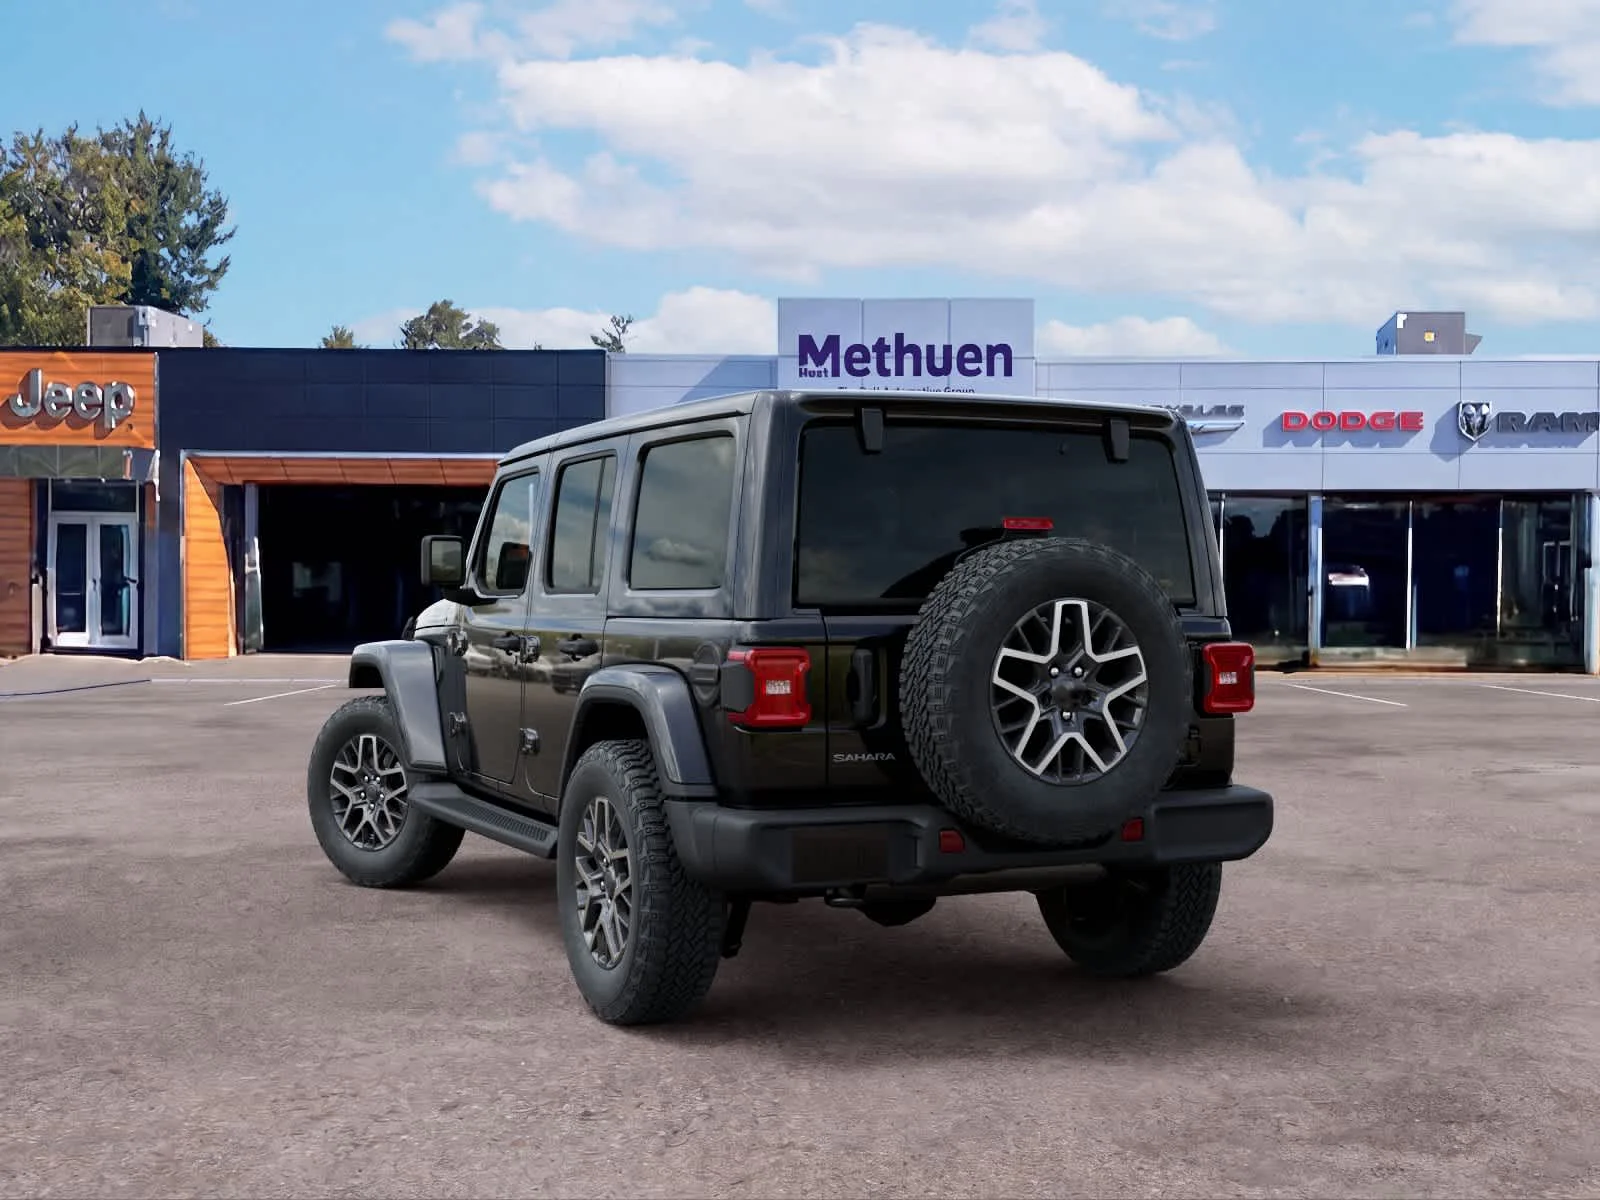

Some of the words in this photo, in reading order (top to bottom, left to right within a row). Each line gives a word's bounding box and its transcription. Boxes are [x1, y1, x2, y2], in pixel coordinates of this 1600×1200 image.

[798, 332, 1013, 378] Methuen
[10, 368, 135, 429] Jeep
[1282, 411, 1424, 432] DODGE
[1497, 411, 1600, 433] RAM
[832, 752, 896, 763] SAHARA
